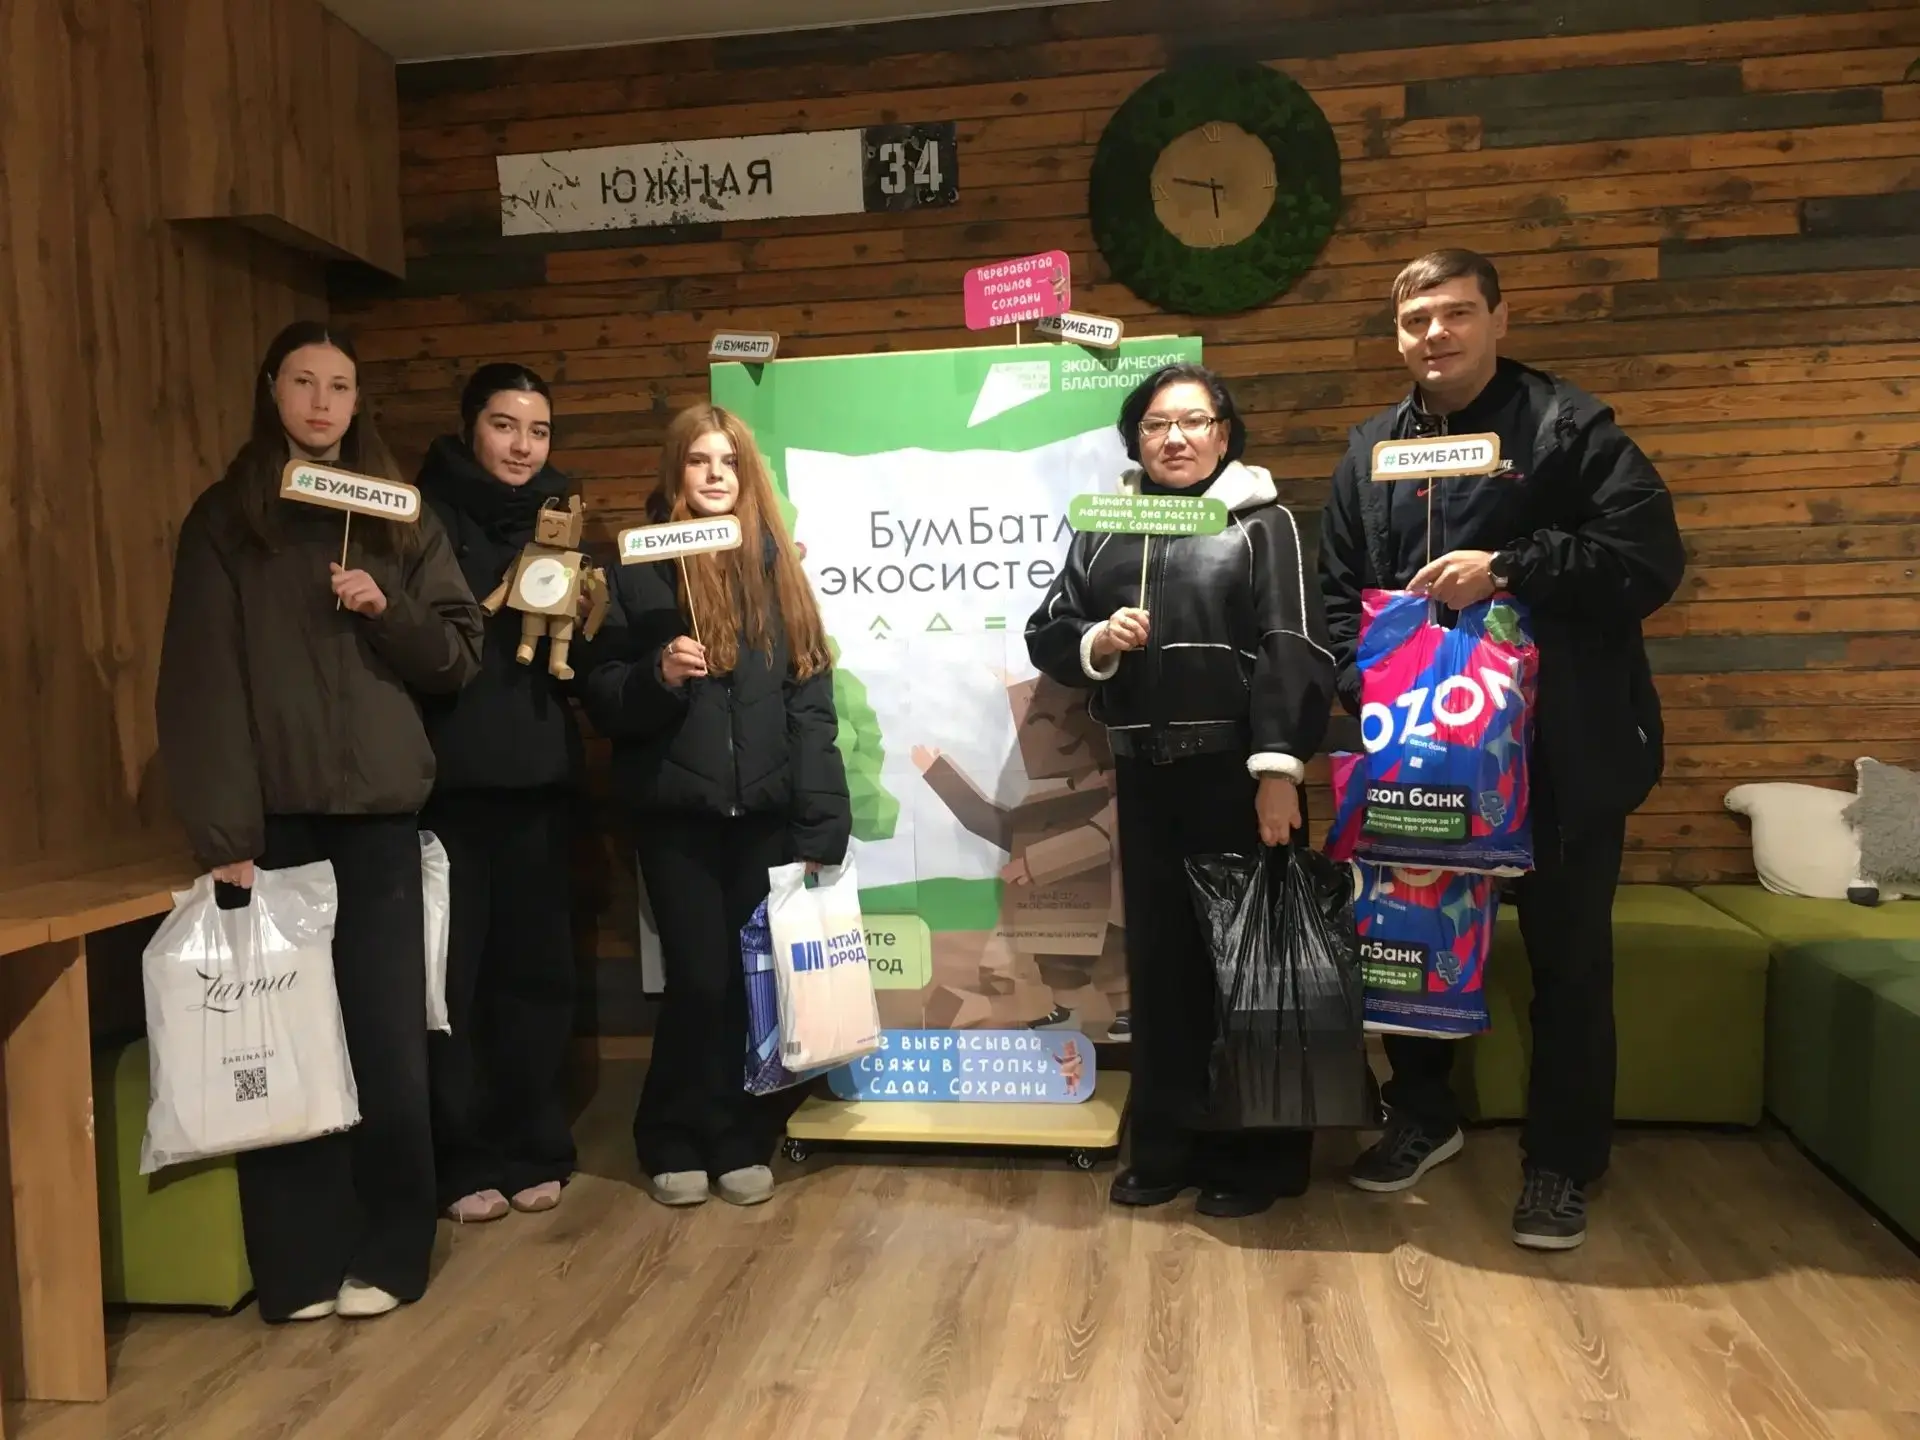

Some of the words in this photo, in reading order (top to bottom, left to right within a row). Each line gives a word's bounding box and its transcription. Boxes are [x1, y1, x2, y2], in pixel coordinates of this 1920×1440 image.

[600, 159, 773, 205] ЮЖНАЯ
[879, 141, 943, 194] 34
[1061, 353, 1186, 373] ЭКОЛОГИЧЕСКОЕ
[1061, 373, 1150, 392] БЛАГОПОЛУ
[1499, 459, 1515, 470] IKE
[1140, 510, 1163, 520] она
[870, 506, 1076, 557] БумБатл
[819, 557, 1055, 596] экосисте
[1409, 787, 1466, 808] банк
[860, 1055, 931, 1073] Свяжи
[942, 1057, 953, 1073] в
[962, 1057, 1057, 1075] стопку.
[949, 1077, 1048, 1096] Сохрани
